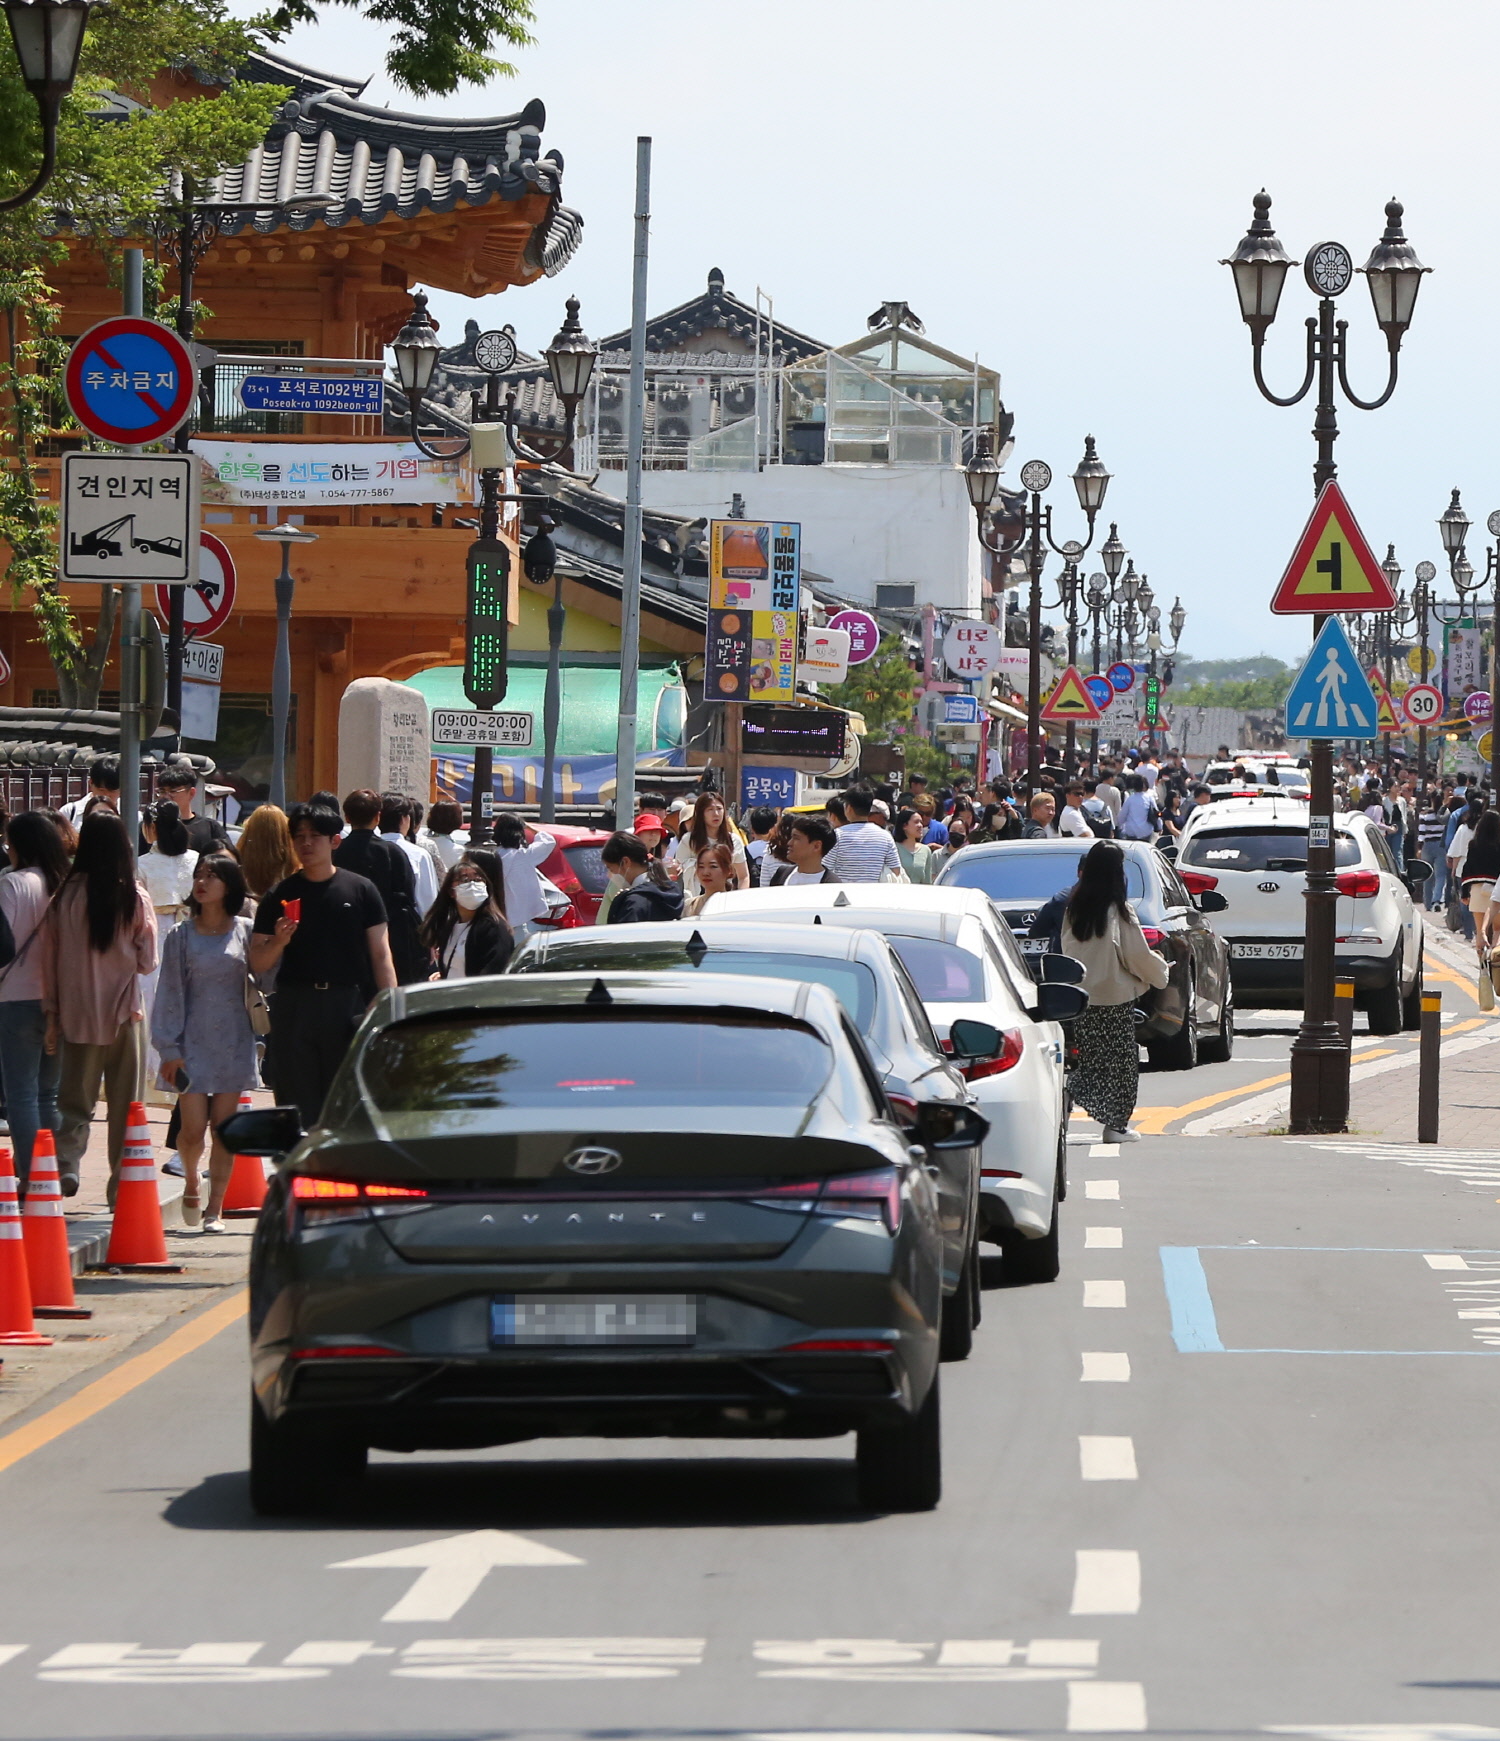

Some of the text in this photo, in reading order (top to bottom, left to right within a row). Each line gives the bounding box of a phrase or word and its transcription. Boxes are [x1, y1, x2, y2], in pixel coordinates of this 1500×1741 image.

[85, 371, 174, 390] 주차금지
[247, 384, 257, 393] 73
[278, 381, 380, 399] 포석로1092번길
[262, 398, 379, 412] Poseok-ro 1092beon-gil
[217, 457, 419, 484] 한옥을 선도하는 기업
[77, 475, 180, 499] 견인지역
[239, 487, 395, 500] (주)태성종합건설 T.054-777-5867
[772, 536, 796, 611] 물품보관
[956, 628, 989, 642] 타로
[850, 638, 866, 651] 로
[968, 645, 978, 655] &
[716, 637, 732, 669] 달고나
[957, 657, 988, 671] 사주
[1413, 697, 1434, 713] 30
[438, 714, 527, 729] 09:00~20:00
[501, 731, 526, 743] 포함)
[745, 776, 792, 800] 골목안
[1260, 883, 1277, 891] KIA
[1267, 945, 1298, 958] 6757
[480, 1211, 706, 1224] AVANTE
[0, 1637, 1101, 1684] 방통행
